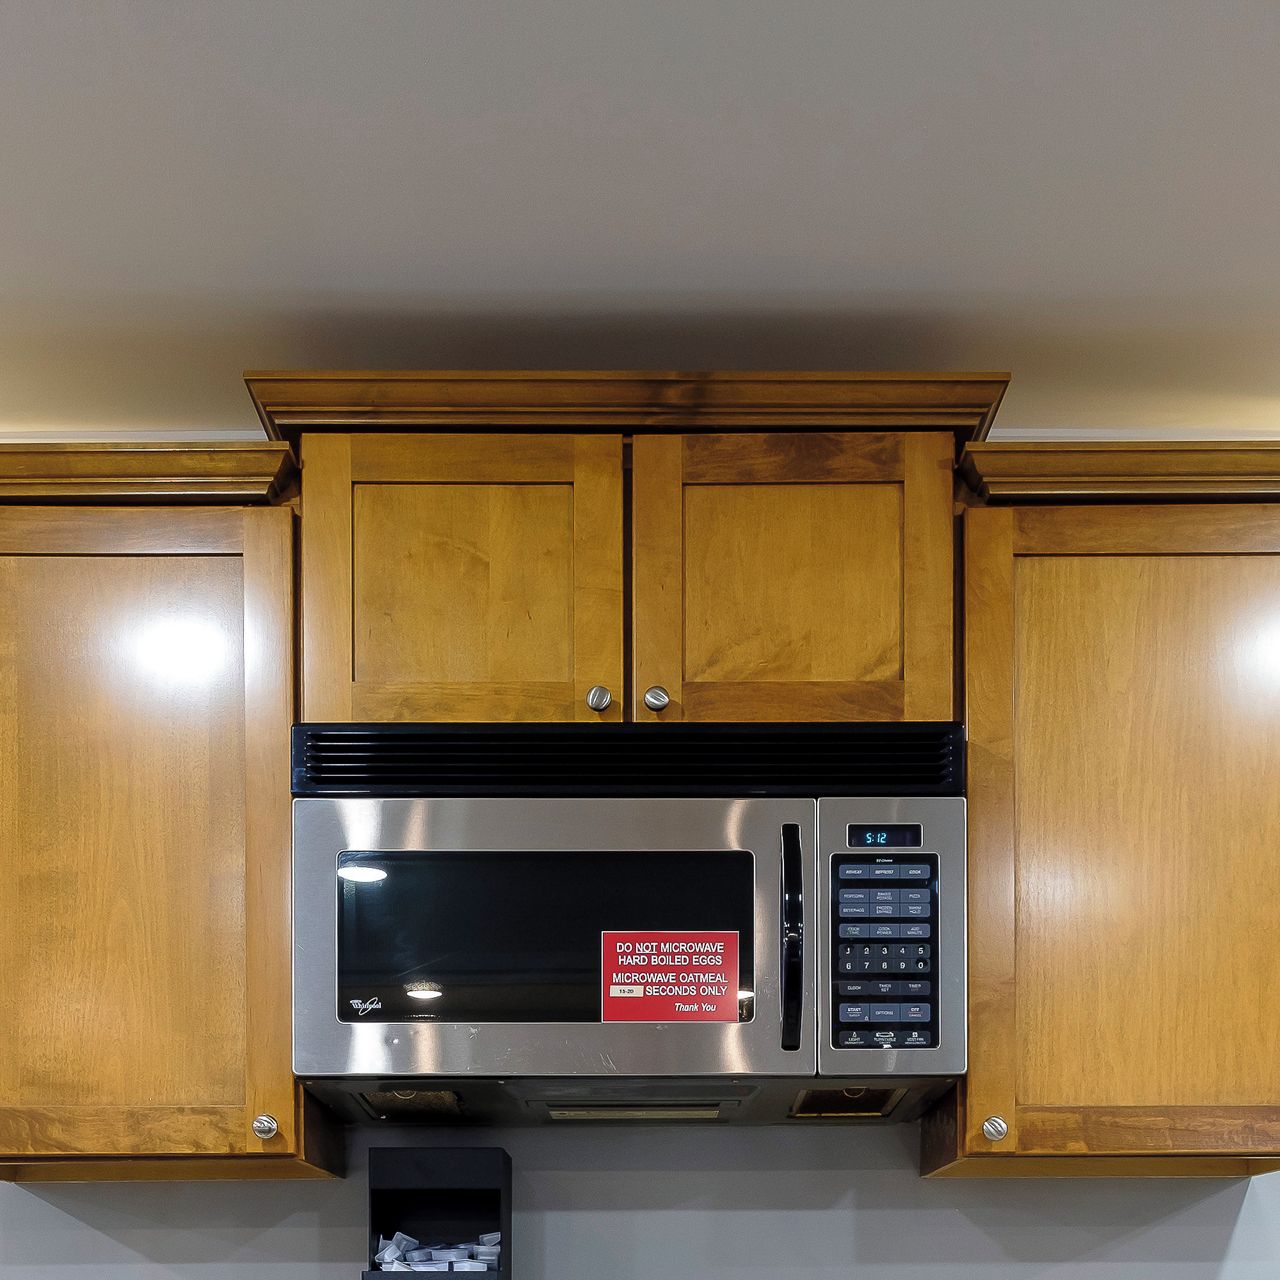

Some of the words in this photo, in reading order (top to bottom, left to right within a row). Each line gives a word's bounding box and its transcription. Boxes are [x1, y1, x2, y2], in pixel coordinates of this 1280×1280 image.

[866, 832, 887, 843] 5:12
[616, 942, 632, 953] DO
[635, 942, 658, 954] NOT
[660, 942, 725, 953] MICROWAVE
[618, 955, 648, 965] HARD
[651, 955, 689, 965] BOILED
[692, 955, 723, 965] EGGS
[612, 973, 676, 983] MICROWAVE
[679, 973, 728, 983] OATMEAL
[645, 985, 697, 996] SECONDS
[699, 985, 728, 996] ONLY
[674, 1002, 699, 1012] Thank
[701, 1002, 716, 1012] You
